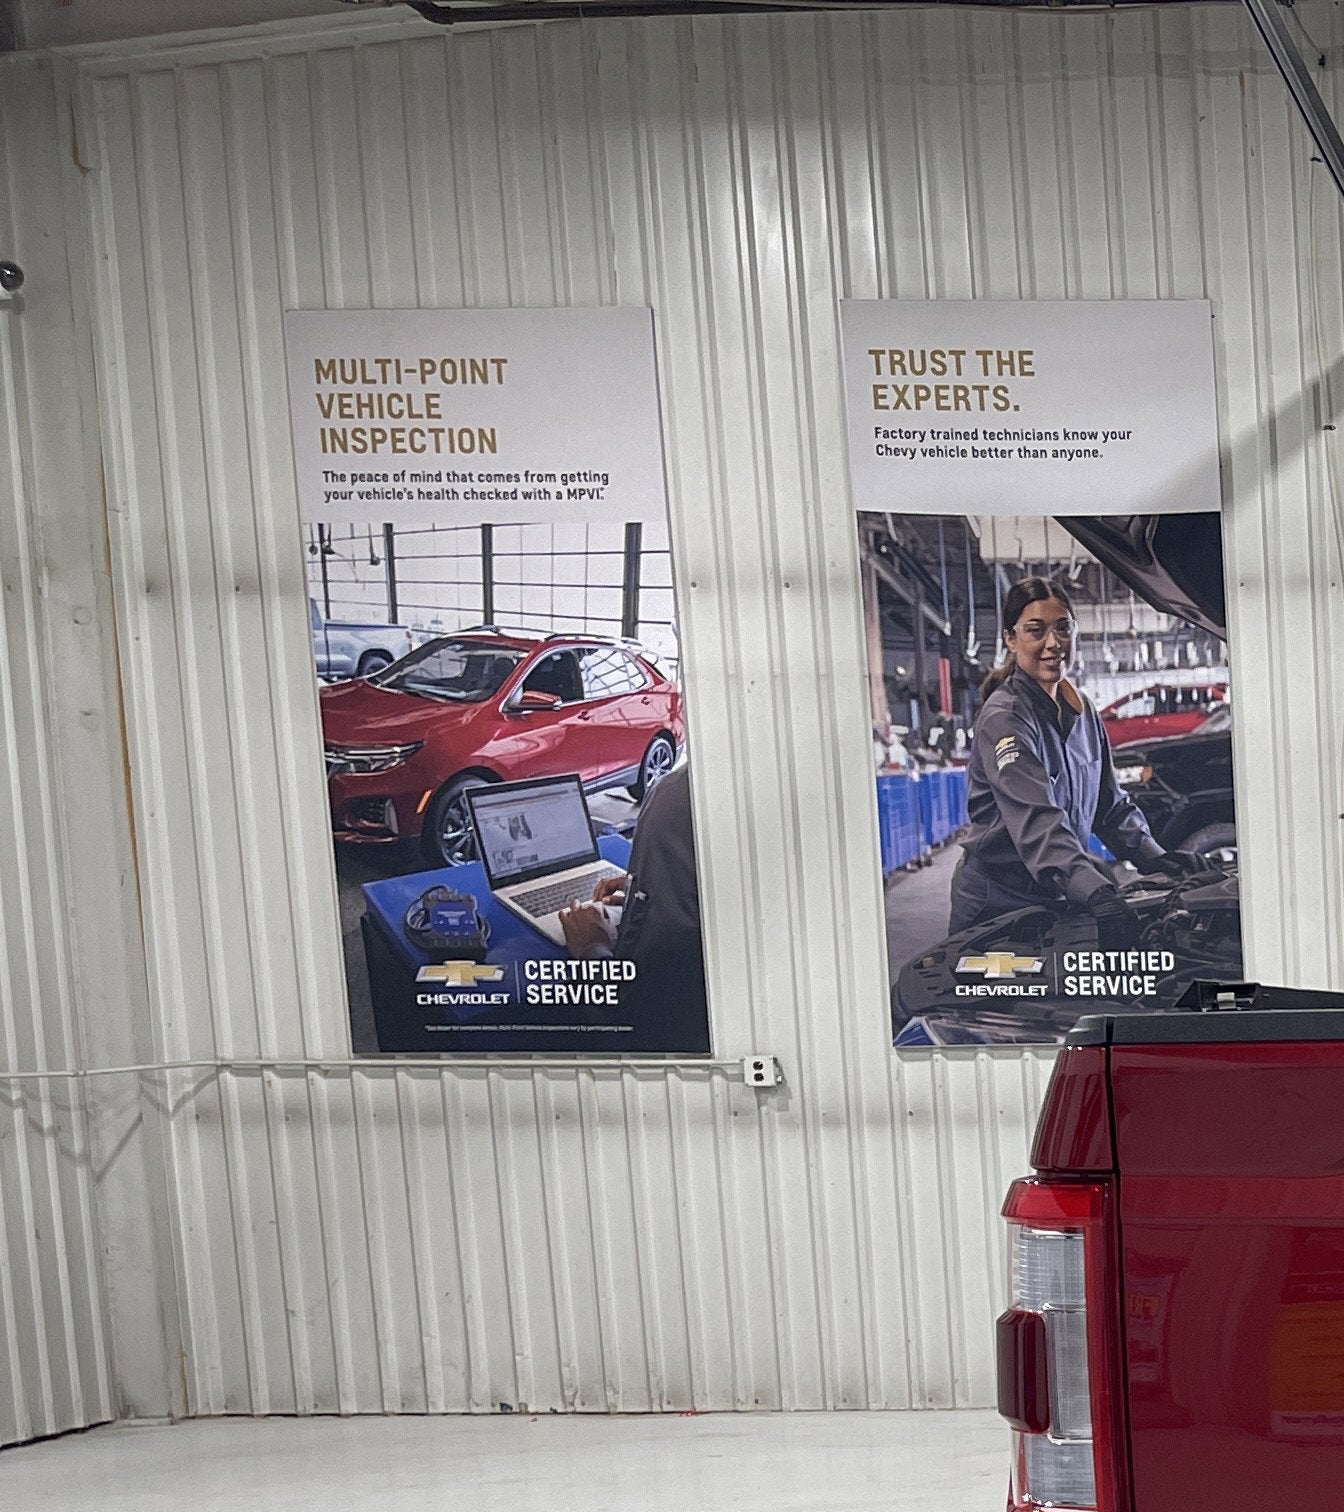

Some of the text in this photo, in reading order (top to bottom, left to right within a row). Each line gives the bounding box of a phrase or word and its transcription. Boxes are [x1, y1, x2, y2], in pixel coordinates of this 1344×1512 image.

[314, 358, 508, 385] MULTI-POINT
[868, 349, 1035, 377] TRUST THE
[315, 392, 442, 420] VEHICLE
[872, 384, 1020, 412] EXPERTS.
[320, 427, 498, 454] INSPECTION
[874, 426, 1133, 443] Factory trained technicians know your
[875, 443, 1104, 461] Chevy vehicle better than anyone.
[322, 470, 609, 487] The peace of mind that comes from getting
[323, 489, 354, 503] your
[357, 487, 414, 501] vehicle's
[417, 487, 460, 501] health
[463, 488, 518, 501] checked
[521, 488, 552, 501] with
[555, 490, 563, 501] a
[524, 960, 637, 982] CERTIFIED
[1063, 951, 1174, 973] CERTIFIED
[526, 984, 618, 1006] SERVICE
[955, 984, 1048, 996] CHEVROLET
[1064, 975, 1157, 996] SERVICE
[416, 992, 510, 1006] CHEVROLET
